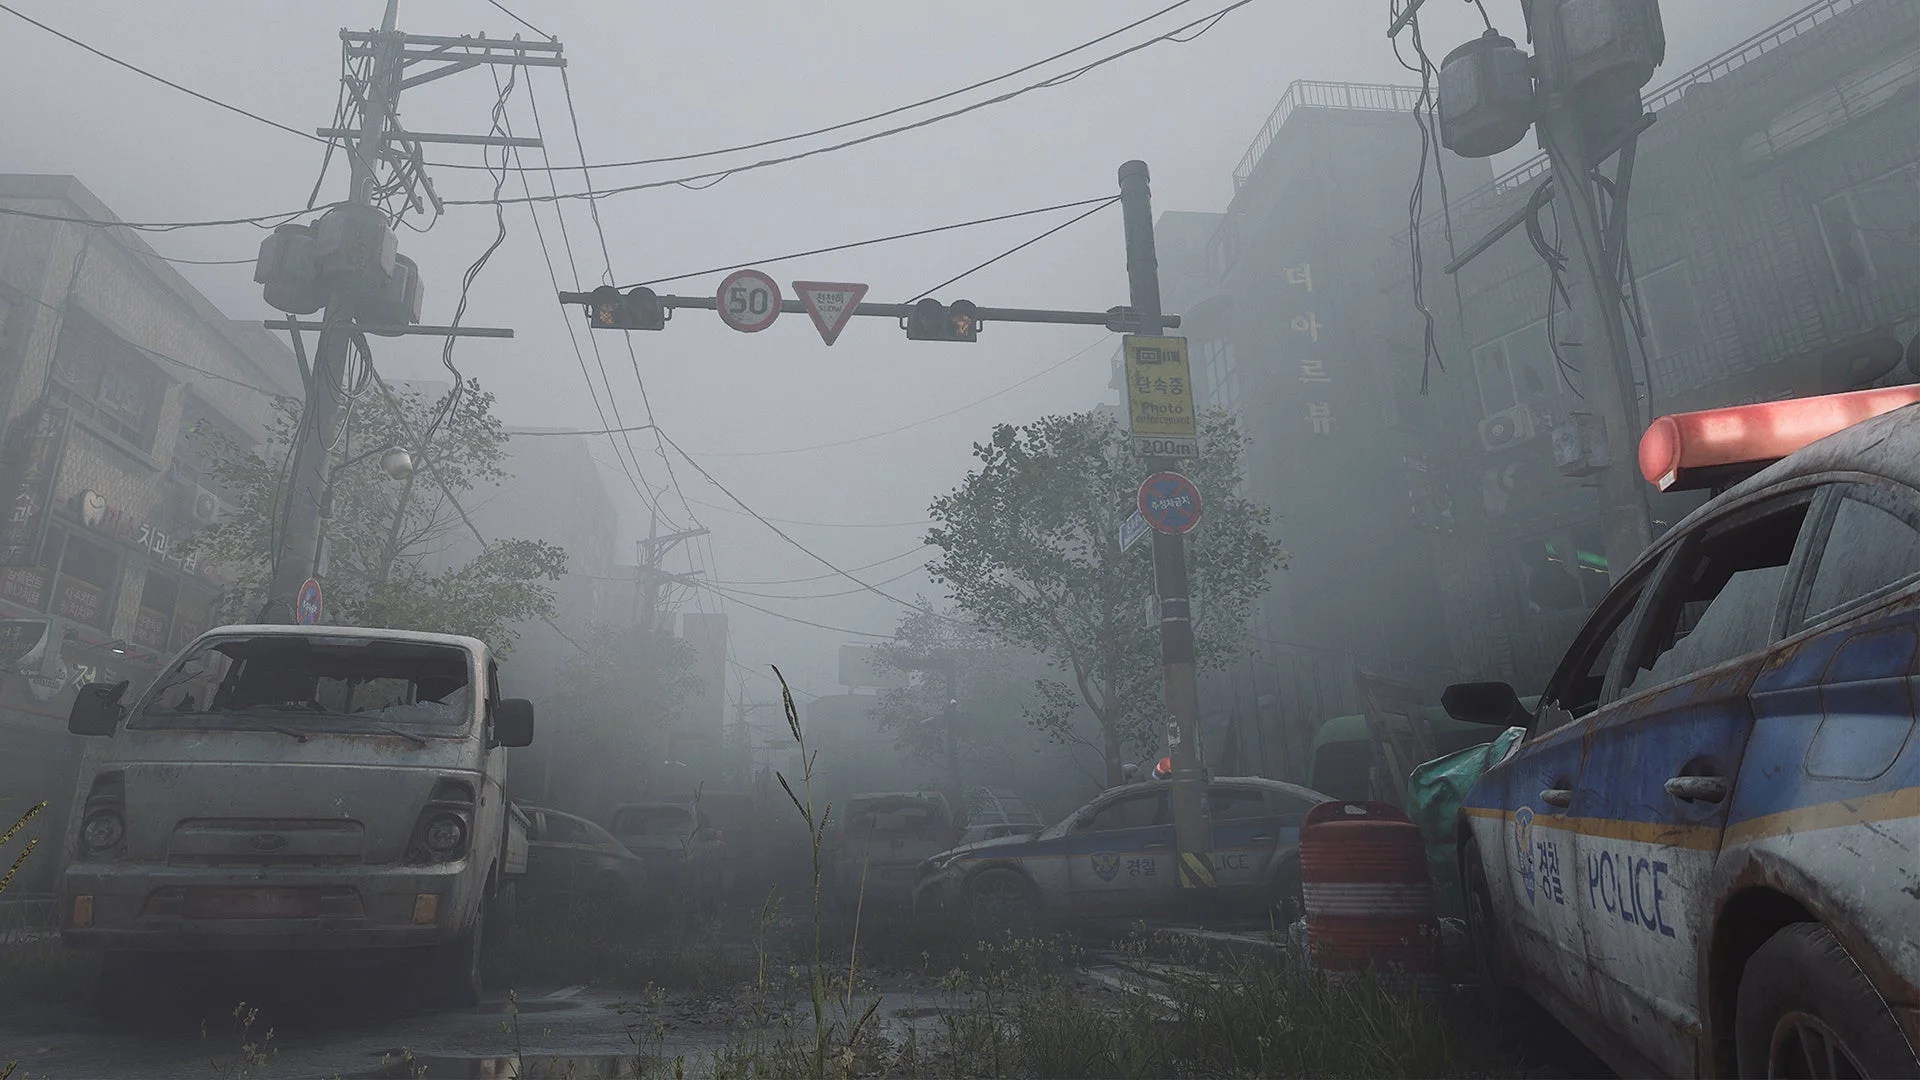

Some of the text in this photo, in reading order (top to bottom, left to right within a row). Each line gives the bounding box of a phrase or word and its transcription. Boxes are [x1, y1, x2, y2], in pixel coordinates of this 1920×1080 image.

[729, 287, 769, 315] 50
[816, 292, 844, 304] 천천히
[818, 304, 843, 313] SLOW
[1136, 376, 1184, 396] 단속중
[1141, 401, 1183, 414] Photo
[1136, 414, 1191, 426] enforcement
[1141, 439, 1191, 455] 200m
[1126, 858, 1156, 877] 경찰
[1214, 854, 1250, 871] LICE
[1537, 840, 1565, 906] 경찰
[1587, 850, 1676, 939] POLICE
